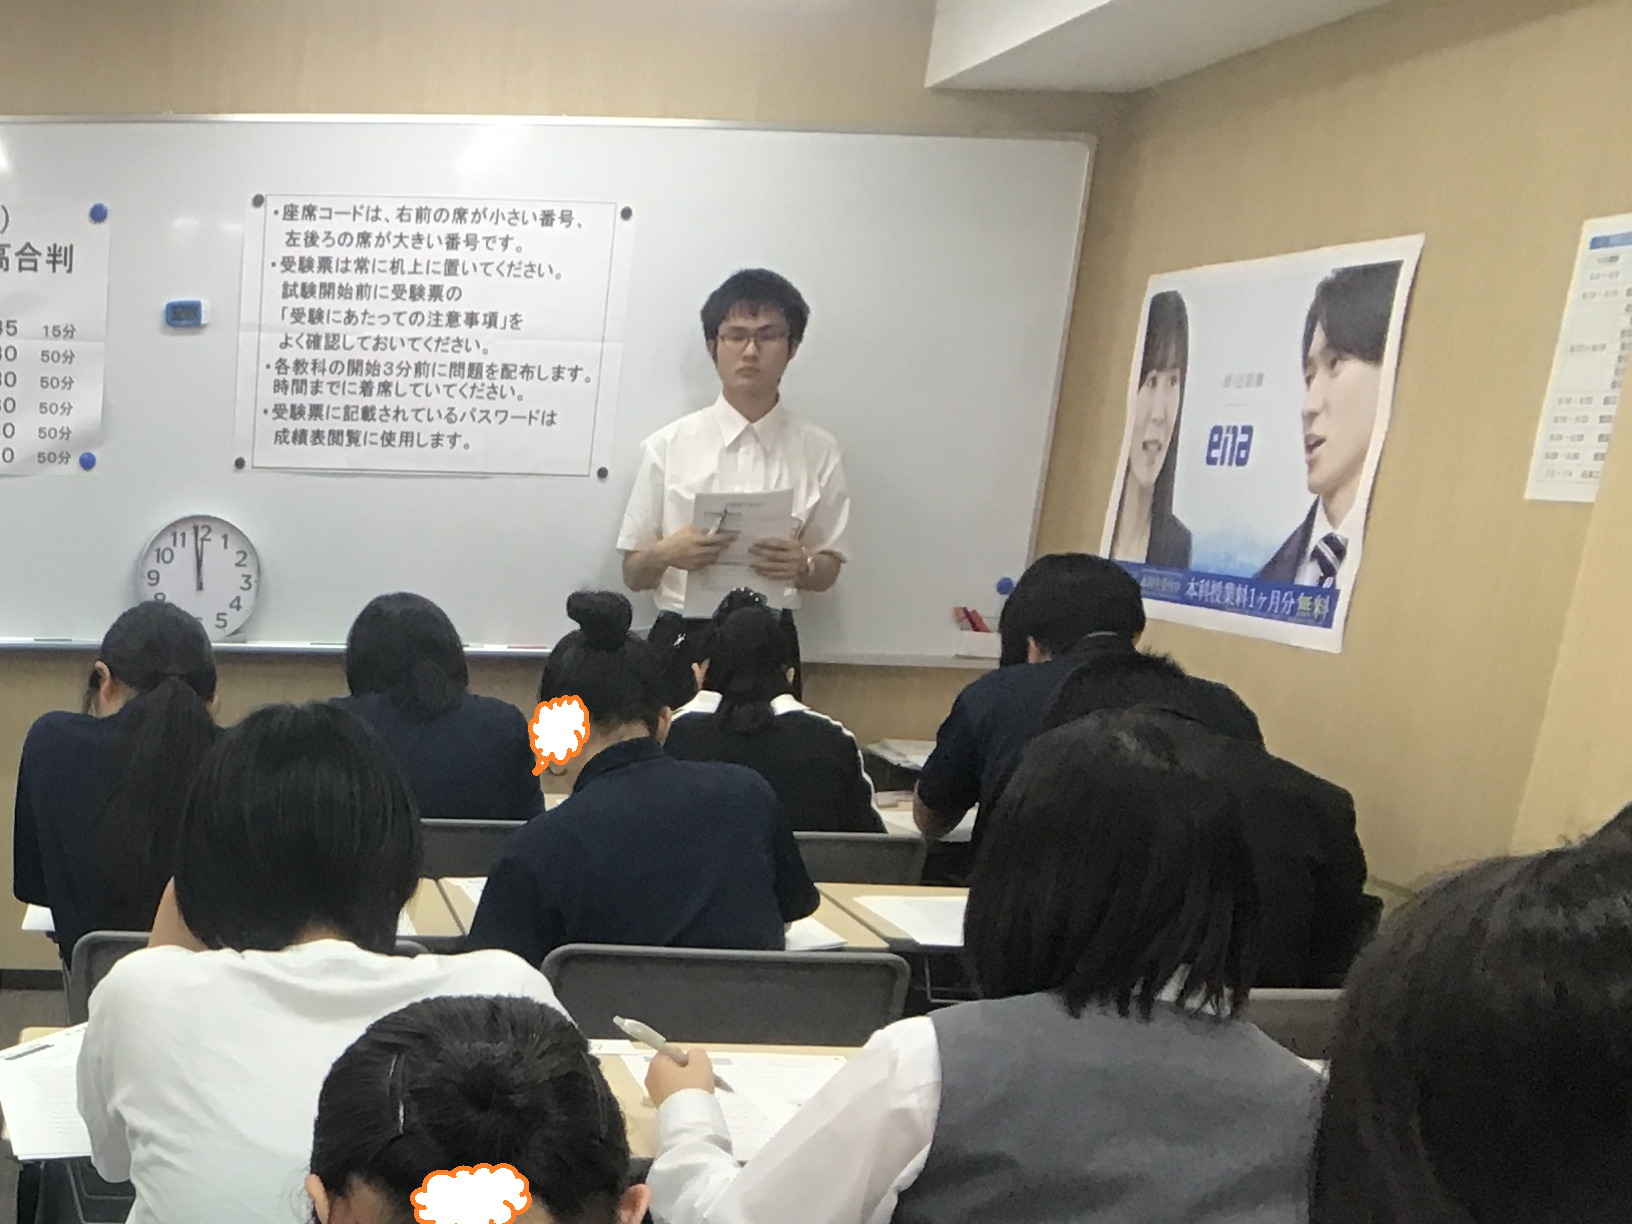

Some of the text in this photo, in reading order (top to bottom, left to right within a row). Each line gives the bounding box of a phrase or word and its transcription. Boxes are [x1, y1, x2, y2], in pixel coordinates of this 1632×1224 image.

[284, 230, 523, 253] 左後ろの席が大きい番号です。
[281, 281, 463, 303] 試験開始前に受験票の
[280, 306, 524, 331] 「受験にあたっての注意事項」を
[42, 323, 77, 340] 15分
[278, 332, 489, 355] よく確認しておいてください。
[40, 349, 76, 365] 50分
[39, 375, 75, 391] 50分
[273, 378, 524, 401] 時間までに着席していてください。
[38, 401, 74, 417] 50分
[37, 426, 72, 442] 50分
[273, 427, 470, 450] 成績表閲覧に使用します。
[1205, 424, 1254, 467] ena
[36, 450, 71, 466] 50分
[171, 531, 186, 548] 11
[221, 533, 229, 550] 1
[154, 547, 174, 564] 10
[234, 550, 247, 567] 2
[147, 569, 160, 587] 9
[239, 574, 252, 591] 3
[229, 595, 242, 611] 4
[214, 612, 227, 629] 5
